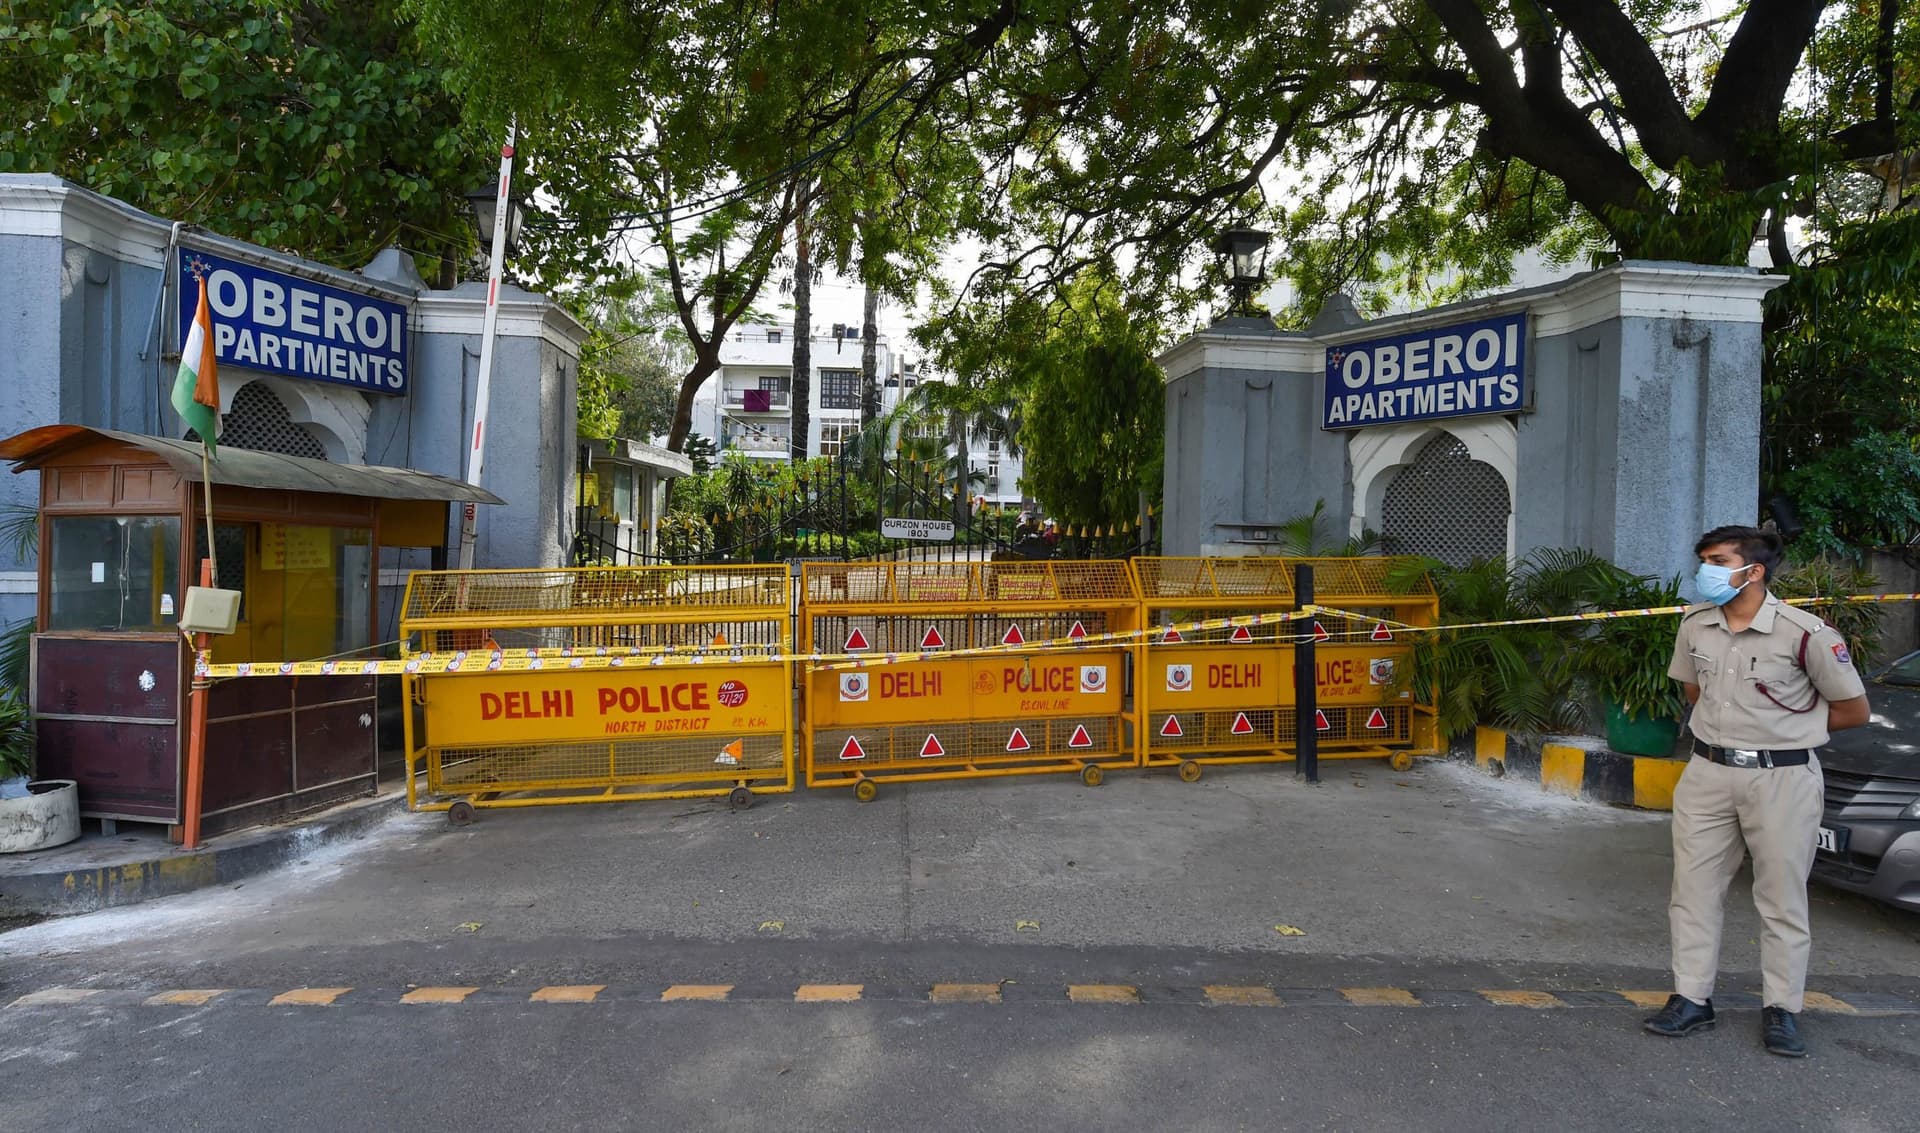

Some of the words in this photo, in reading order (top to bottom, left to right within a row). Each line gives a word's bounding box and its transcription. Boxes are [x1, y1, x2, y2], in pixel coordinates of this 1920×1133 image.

[207, 269, 401, 354] OBEROI
[214, 322, 403, 389] PARTMENTS
[1342, 324, 1518, 389] OBEROI
[1328, 373, 1519, 424] APARTMENTS
[464, 503, 475, 521] TOP
[884, 520, 920, 529] CURZON
[922, 522, 952, 531] HOUSE
[907, 529, 929, 538] 1903
[880, 670, 942, 699] DELHI
[1003, 667, 1075, 693] POLICE
[1208, 663, 1261, 689] DELHI
[1293, 659, 1353, 688] LICE
[480, 688, 574, 721] DELHI
[598, 682, 711, 715] POLICE
[605, 720, 646, 734] NORTH
[654, 717, 711, 732] DISTRICT
